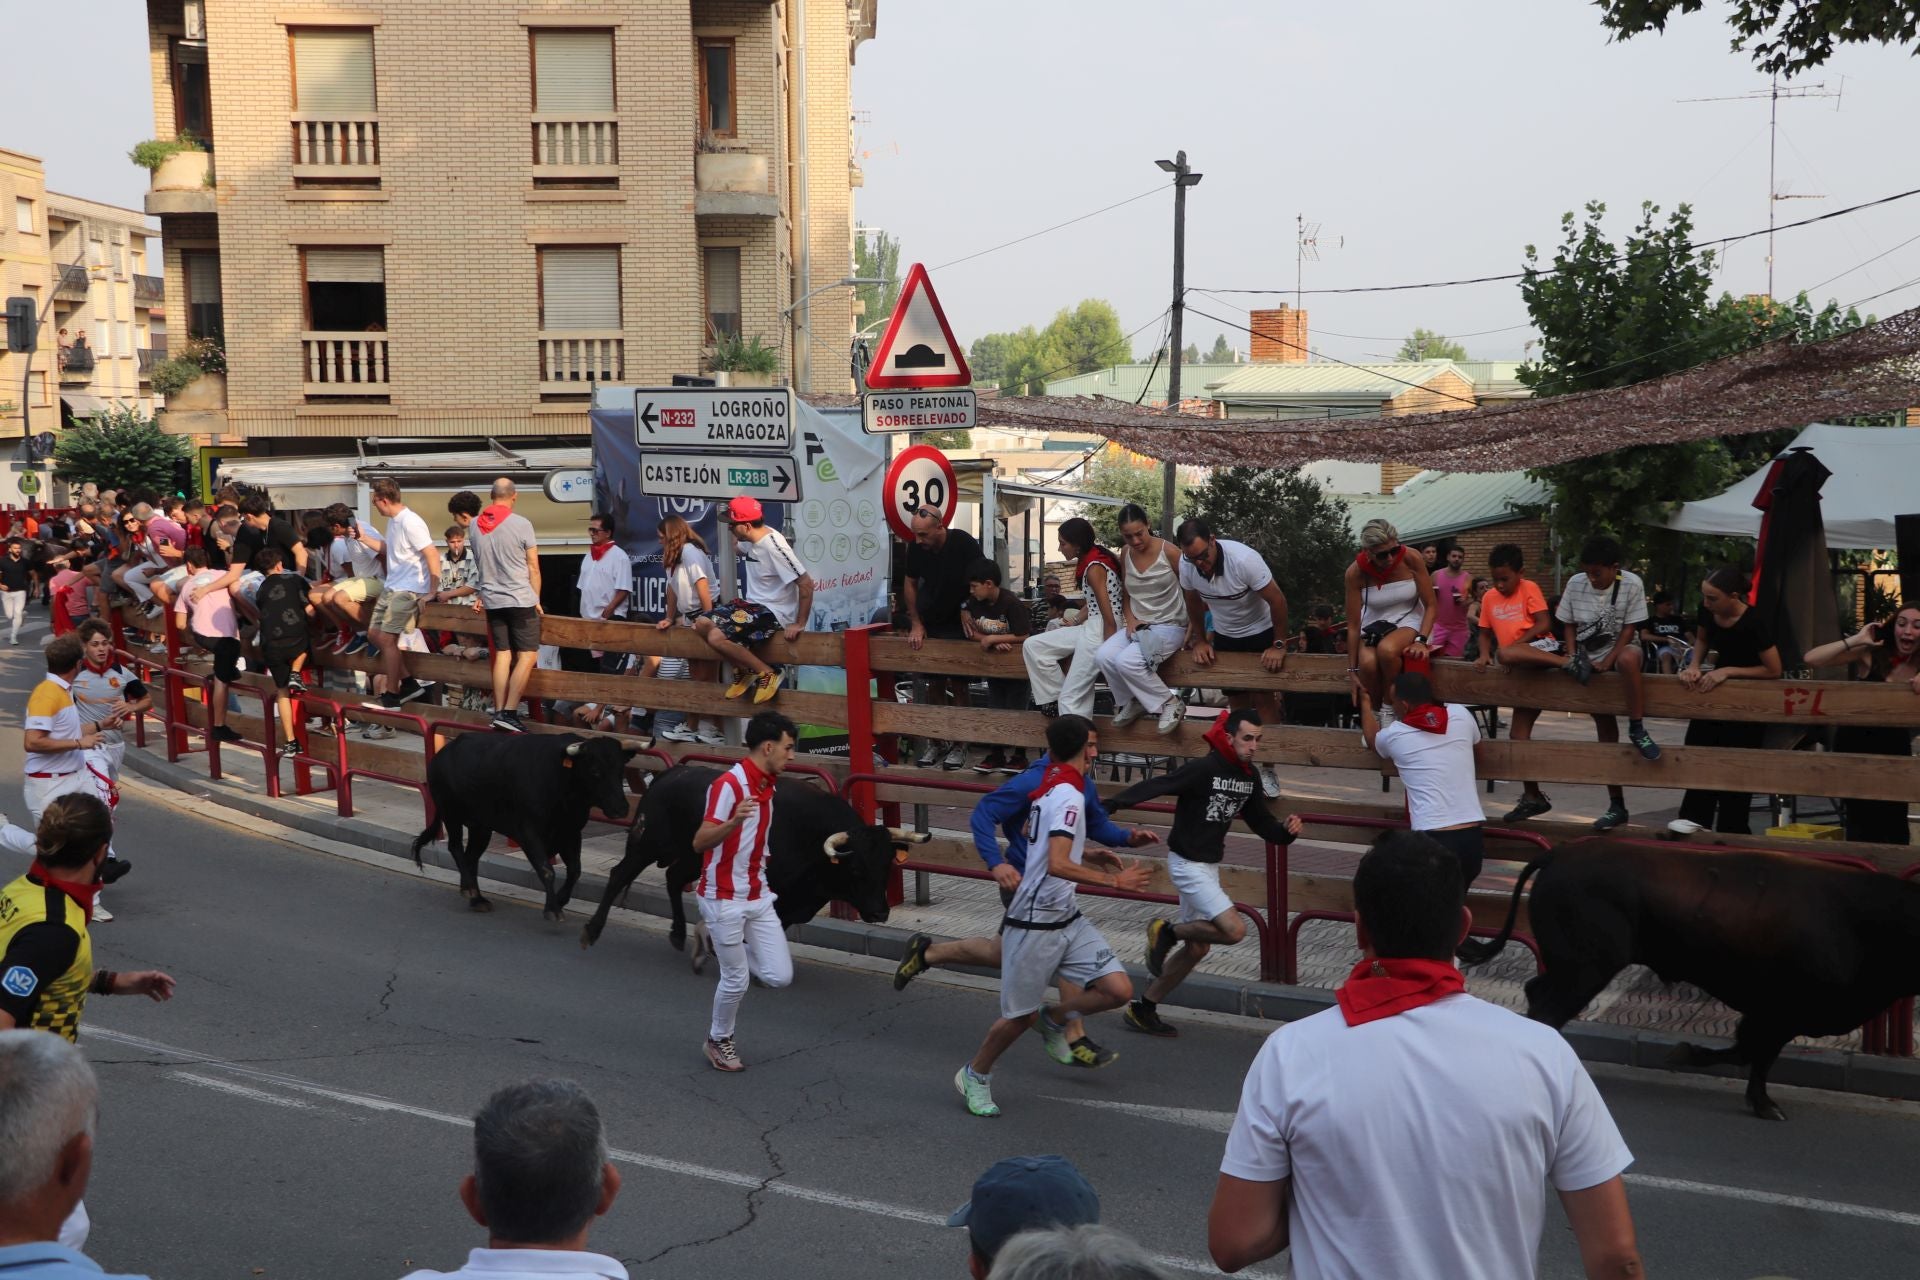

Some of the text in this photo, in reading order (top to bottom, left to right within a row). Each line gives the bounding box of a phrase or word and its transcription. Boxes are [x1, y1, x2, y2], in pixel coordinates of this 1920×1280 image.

[712, 398, 786, 418] LOGROÑO
[872, 396, 970, 411] PASO PEATONAL
[662, 411, 694, 425] N-232
[876, 412, 967, 427] SOBREELEVADO
[707, 423, 786, 441] ZARAGOZA
[645, 463, 721, 485] CASTEJÓN
[728, 471, 768, 485] LR-288
[902, 477, 944, 513] 30
